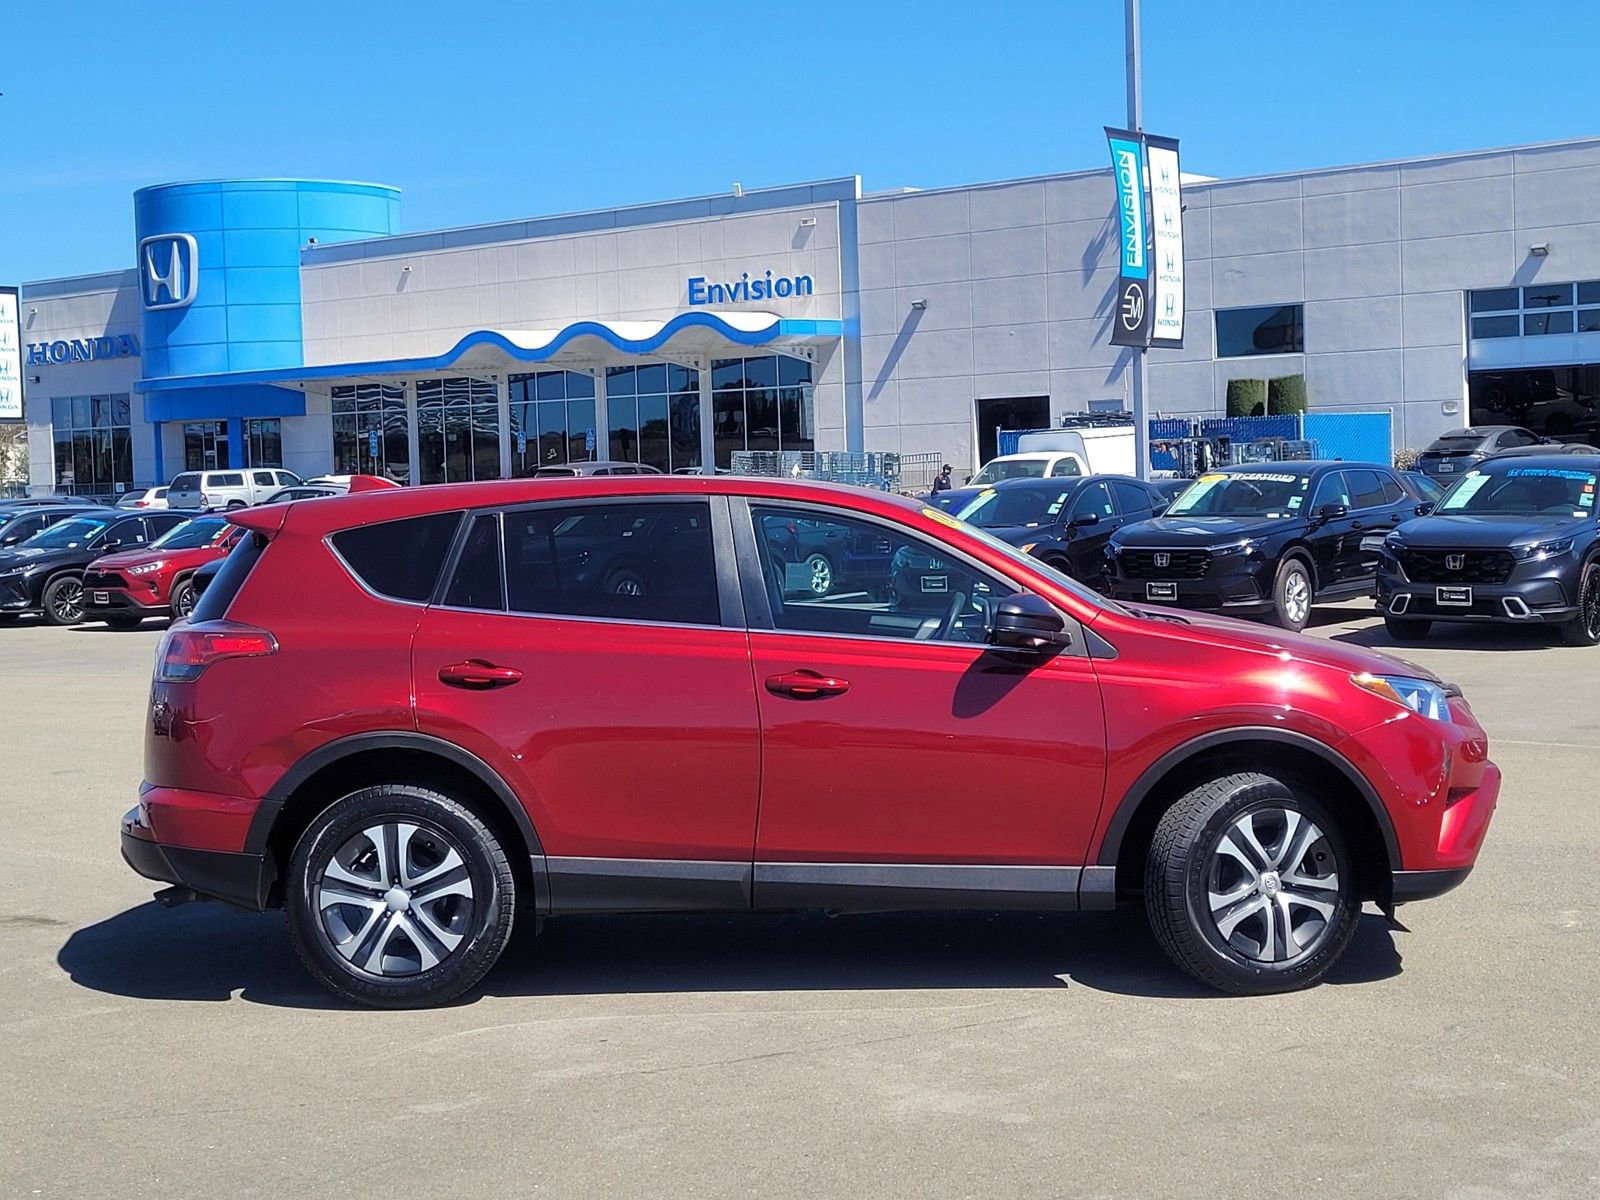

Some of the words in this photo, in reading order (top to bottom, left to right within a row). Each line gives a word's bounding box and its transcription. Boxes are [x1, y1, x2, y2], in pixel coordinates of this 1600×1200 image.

[1117, 149, 1138, 268] ENVISION
[688, 270, 813, 306] Envision
[26, 334, 141, 366] HONDA
